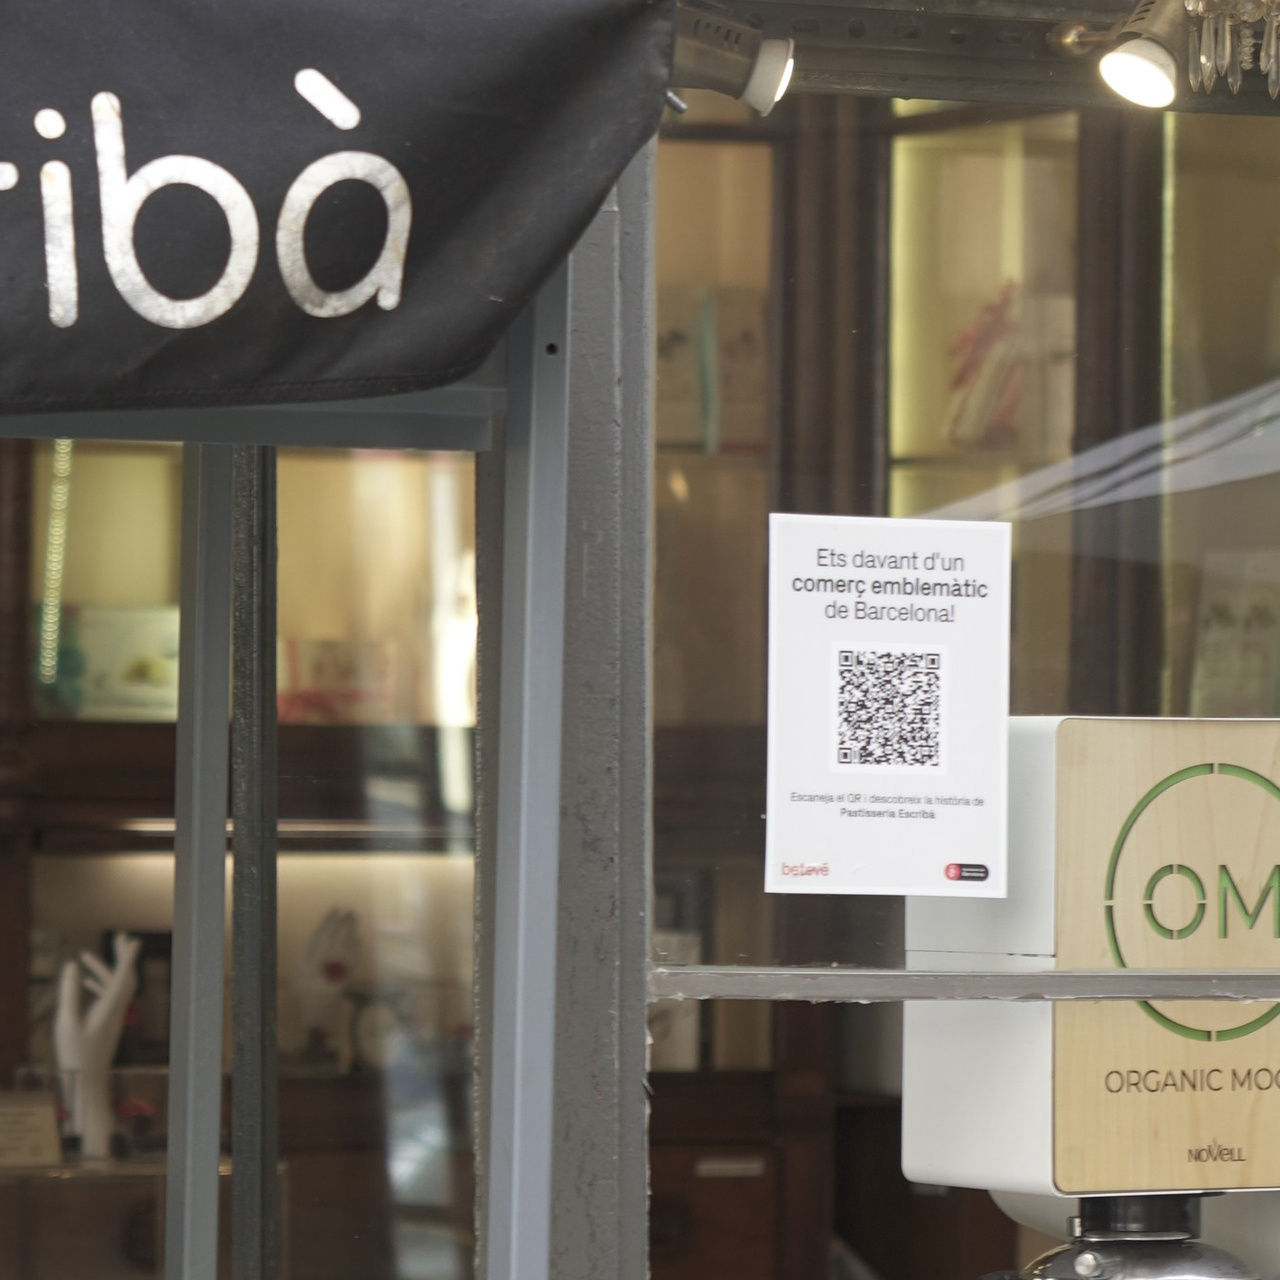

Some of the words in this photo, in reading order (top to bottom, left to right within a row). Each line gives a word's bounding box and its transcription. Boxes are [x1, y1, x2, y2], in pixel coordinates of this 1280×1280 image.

[816, 548, 847, 568] Ets
[852, 550, 918, 570] davant
[923, 552, 965, 572] d'un
[791, 577, 866, 598] comerç
[871, 577, 989, 598] emblemàtic
[824, 601, 849, 619] de
[854, 601, 956, 622] Barcelona!
[972, 797, 985, 807] de
[840, 807, 895, 819] Pastisseria
[1104, 1068, 1224, 1093] ORGANIC
[1231, 1067, 1280, 1092] MO
